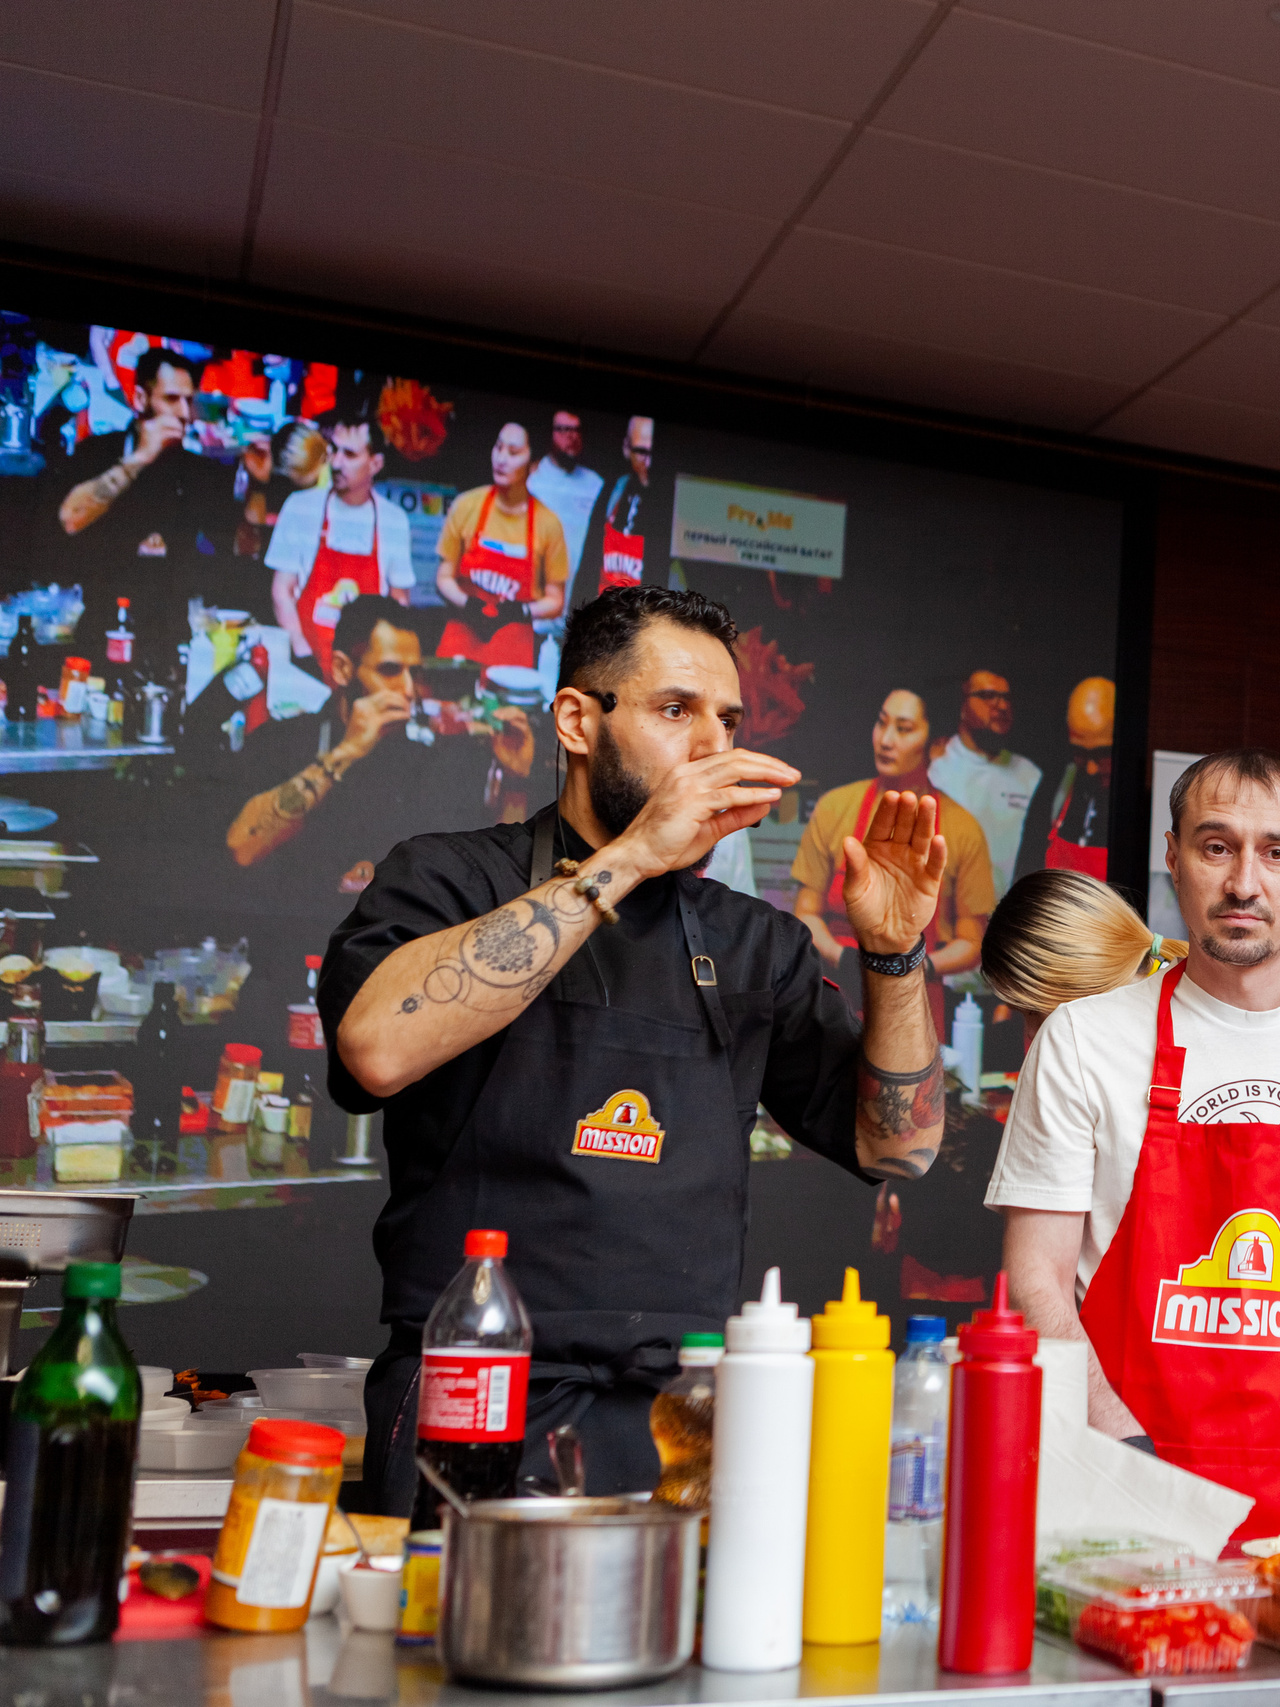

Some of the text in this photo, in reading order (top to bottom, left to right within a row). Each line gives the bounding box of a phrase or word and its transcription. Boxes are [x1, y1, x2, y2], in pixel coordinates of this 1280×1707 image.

[603, 552, 643, 580] HEINZ
[470, 568, 521, 602] HEINZ
[1245, 1085, 1261, 1097] IS
